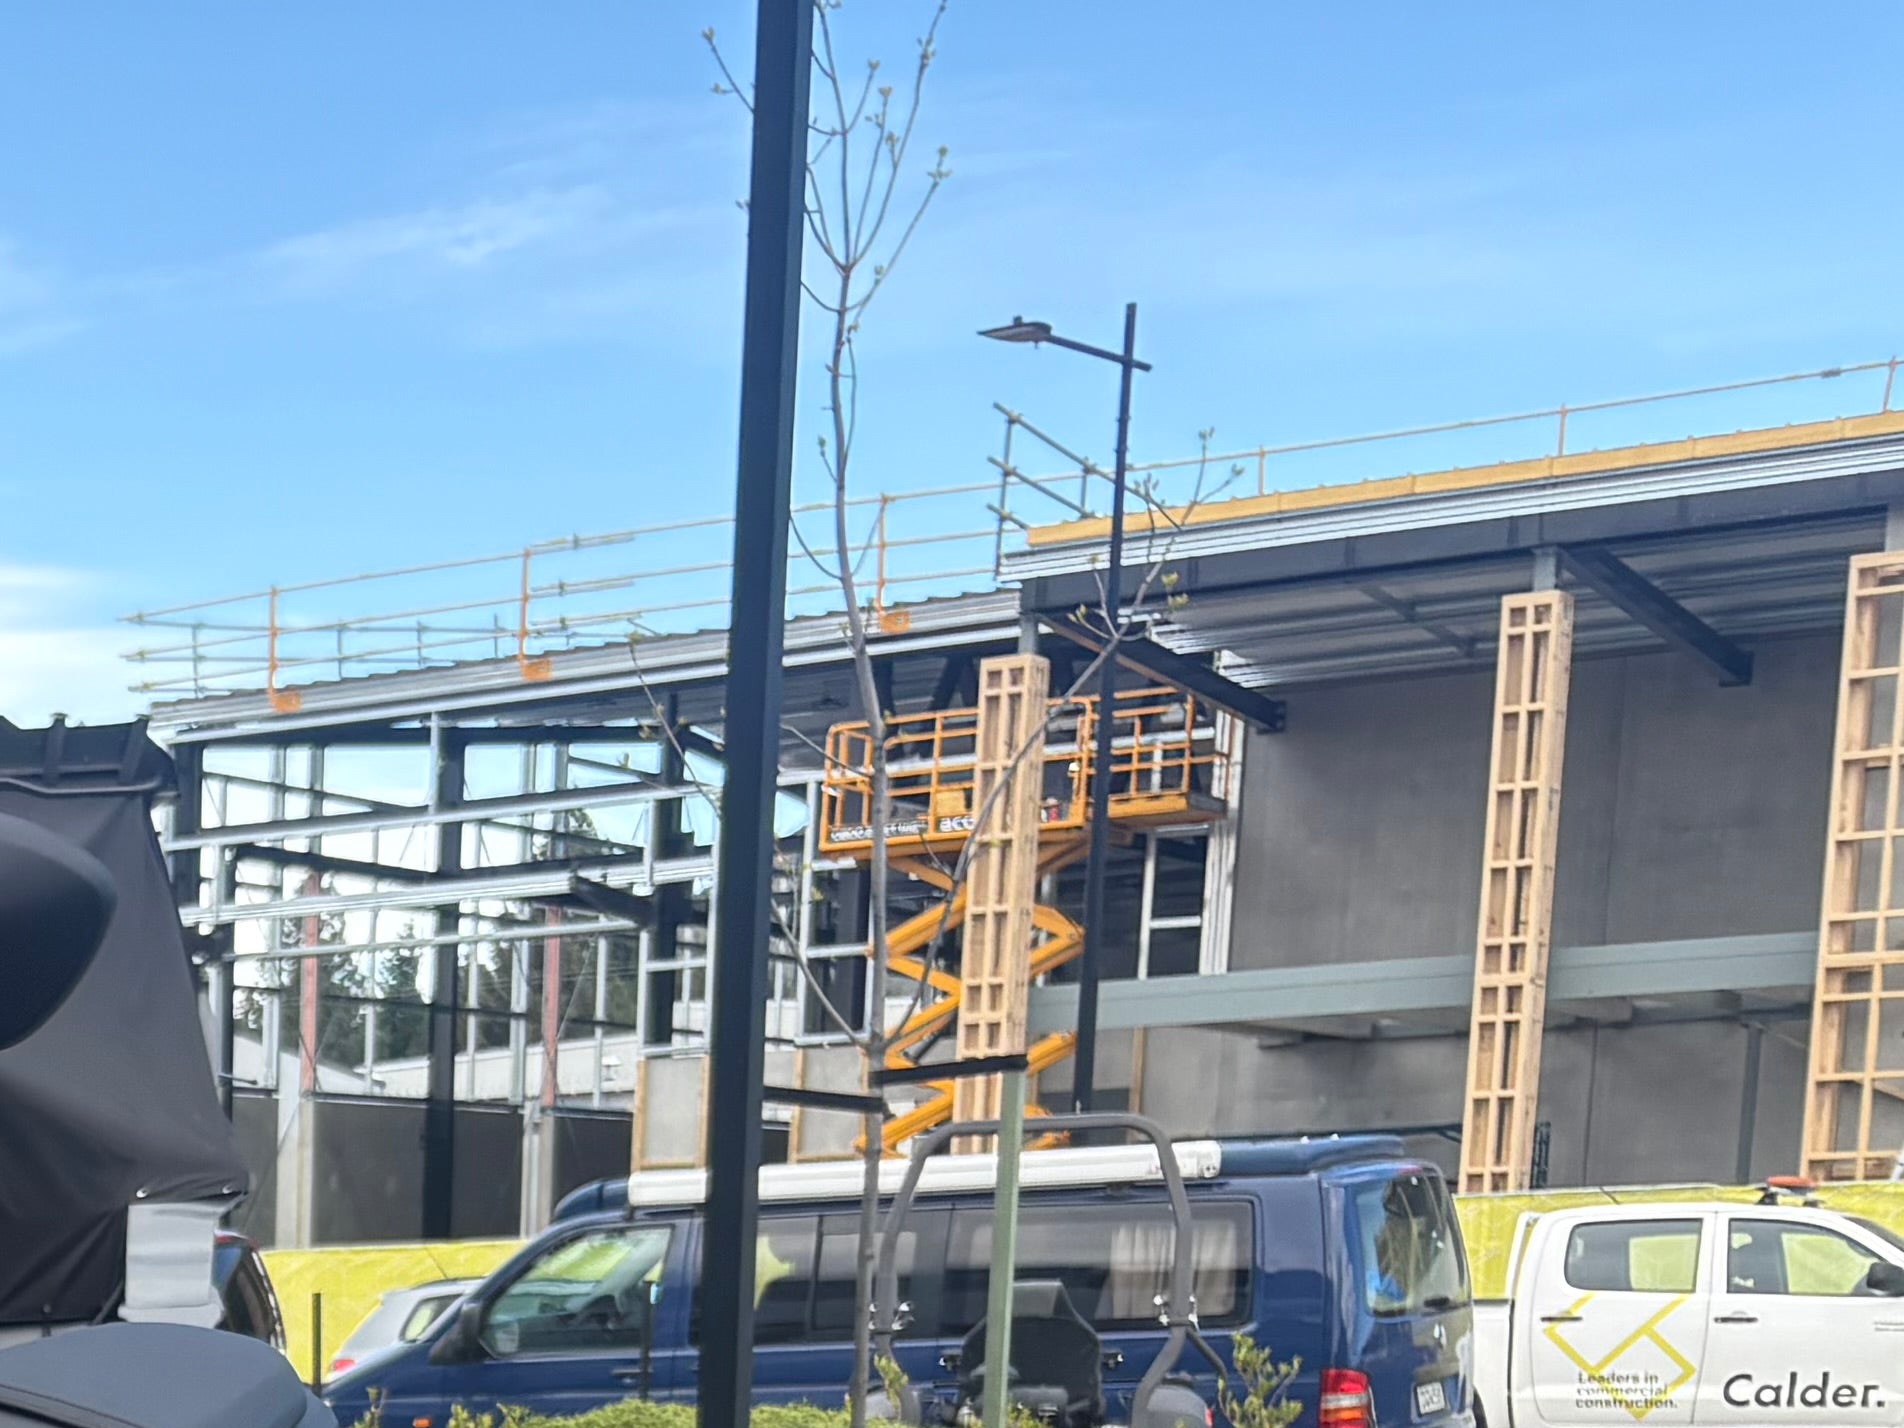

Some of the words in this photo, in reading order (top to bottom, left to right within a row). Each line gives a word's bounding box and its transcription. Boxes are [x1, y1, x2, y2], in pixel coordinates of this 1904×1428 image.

[1578, 1370, 1640, 1384] Leaders
[1644, 1370, 1659, 1384] in
[1577, 1383, 1668, 1396] commercial
[1723, 1371, 1886, 1408] Calder.
[1575, 1396, 1678, 1409] construction.
